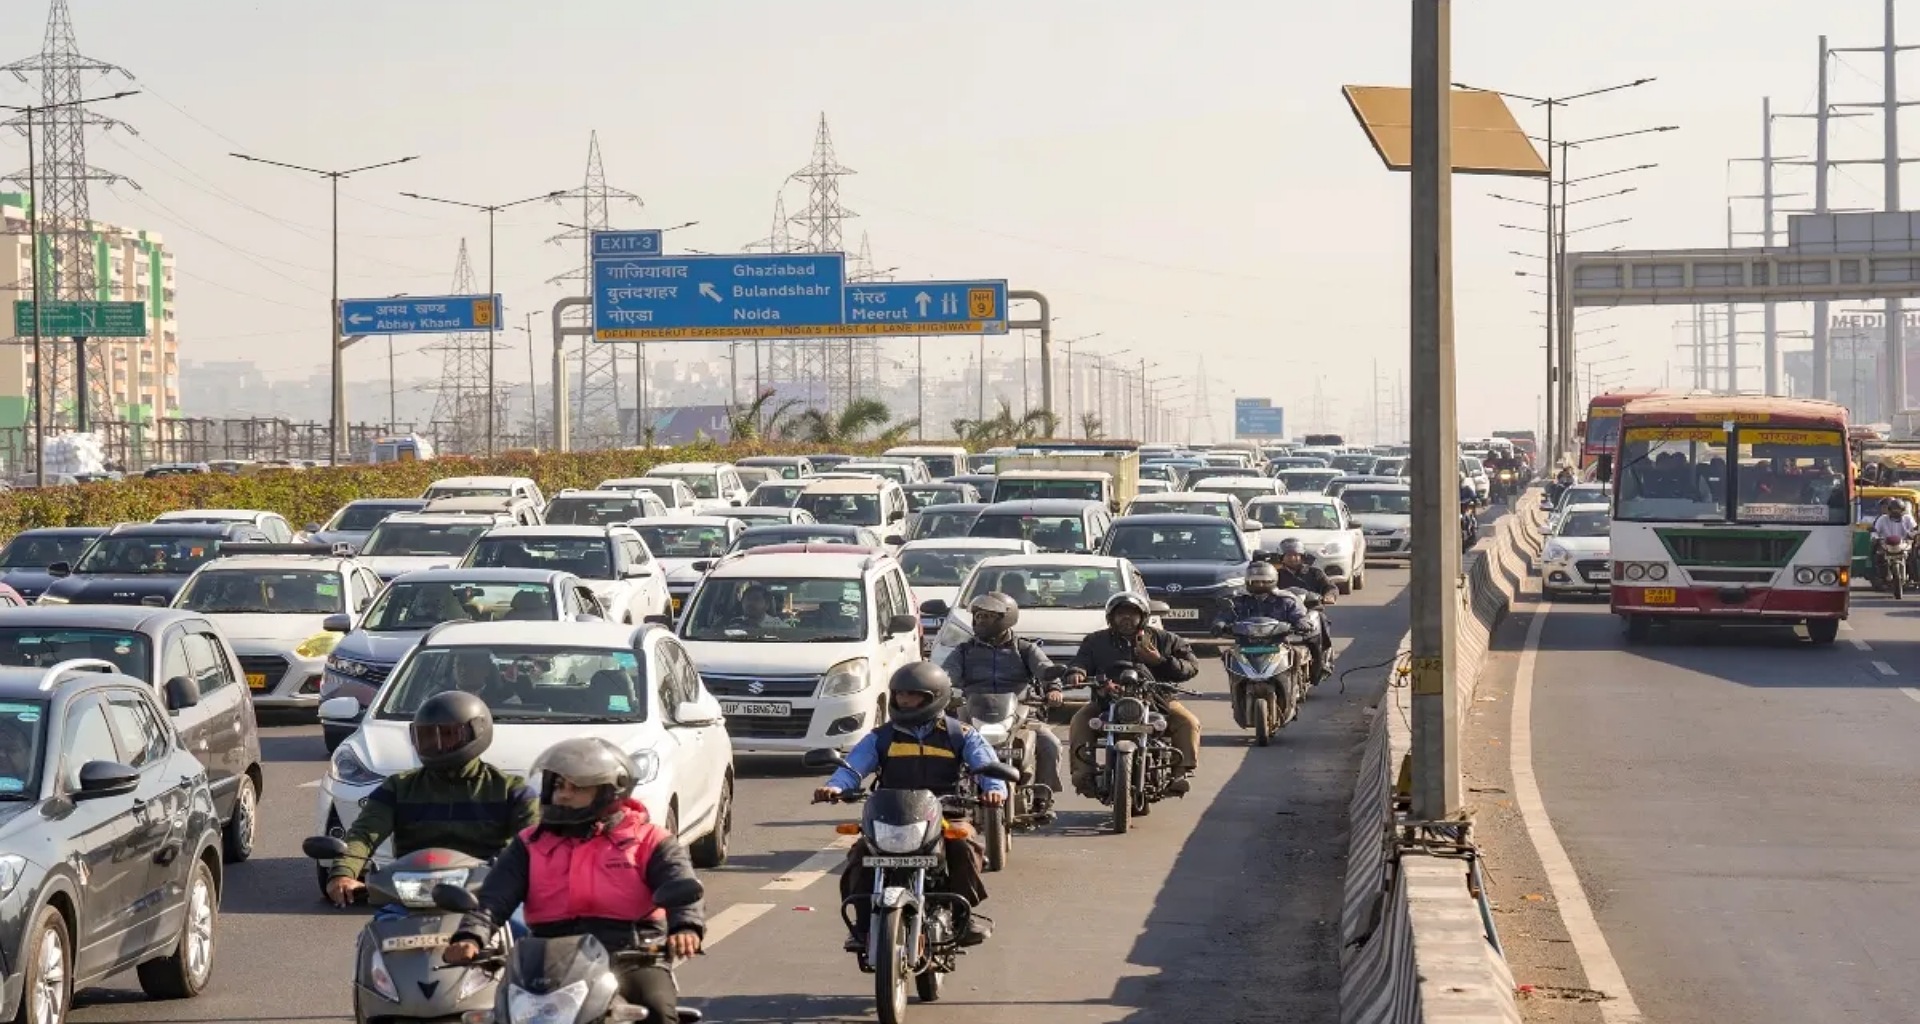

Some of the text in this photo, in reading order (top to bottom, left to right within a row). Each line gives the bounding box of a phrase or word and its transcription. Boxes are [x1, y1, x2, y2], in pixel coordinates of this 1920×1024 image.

[601, 236, 652, 249] EXIT-3
[733, 262, 815, 277] Ghaziabad
[606, 283, 678, 304] बुलंदशहर
[733, 283, 831, 298] Bulandshahr
[852, 288, 887, 304] मेरठ
[973, 293, 990, 301] NH
[606, 306, 653, 324] नोएडा
[733, 307, 780, 320] Noida
[852, 307, 908, 320] Meerut
[977, 303, 986, 313] 9
[376, 317, 460, 331] Abhay Khand
[604, 329, 637, 338] DELHI
[641, 328, 687, 337] MEERUT
[690, 327, 765, 336] EXPRESSWAY
[780, 325, 822, 335] INDIA'S
[828, 325, 859, 335] FIRST
[883, 324, 912, 332] LANE
[918, 323, 973, 331] HIGHWAY
